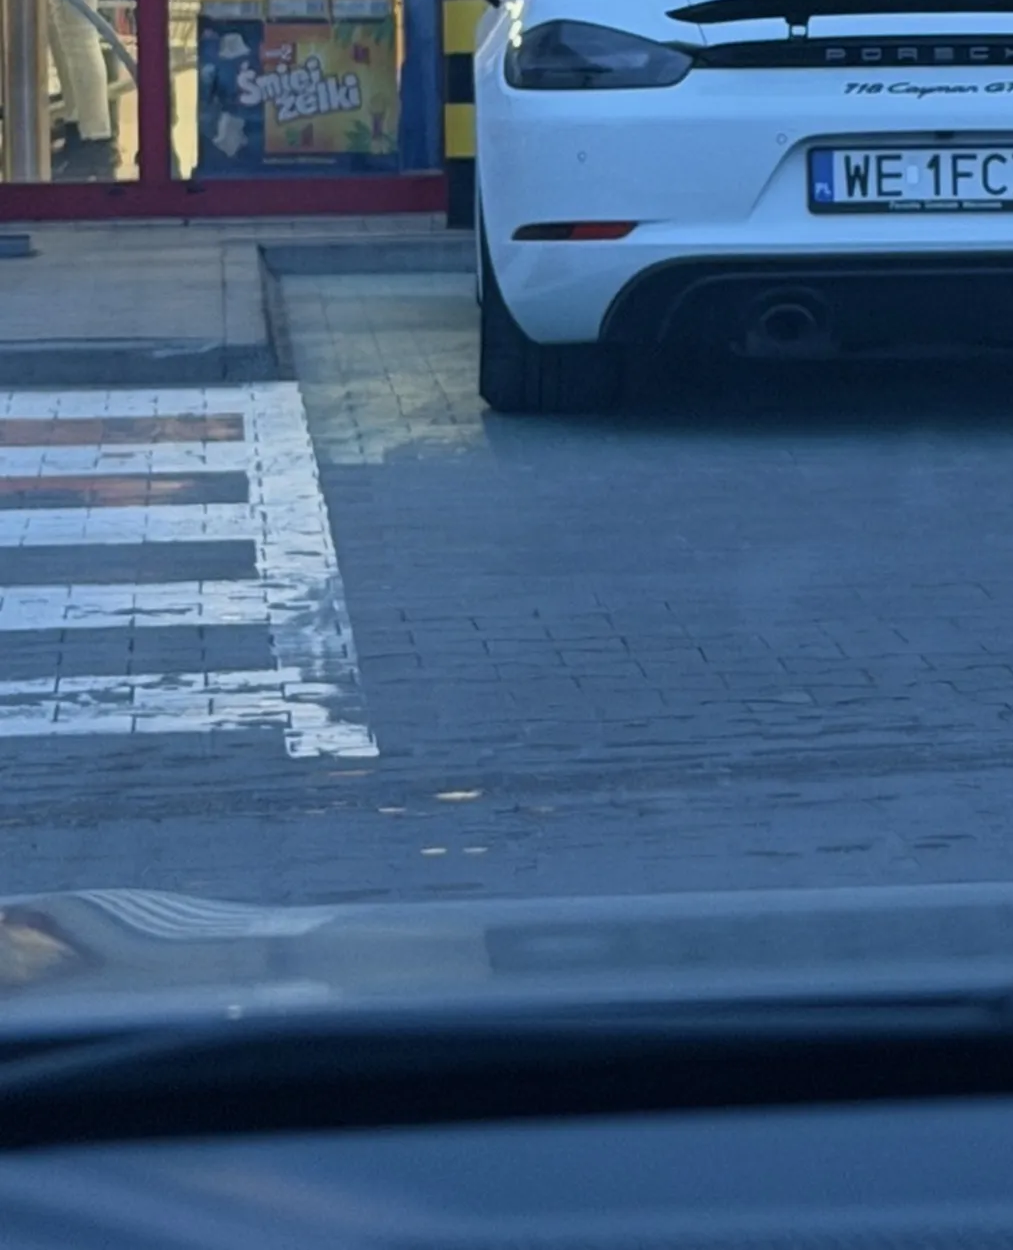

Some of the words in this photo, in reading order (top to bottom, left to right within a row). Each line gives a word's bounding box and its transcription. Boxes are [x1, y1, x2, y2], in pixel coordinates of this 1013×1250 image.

[844, 81, 881, 95] 718
[887, 81, 977, 99] Cayman
[815, 182, 832, 196] PL
[845, 153, 903, 198] WE
